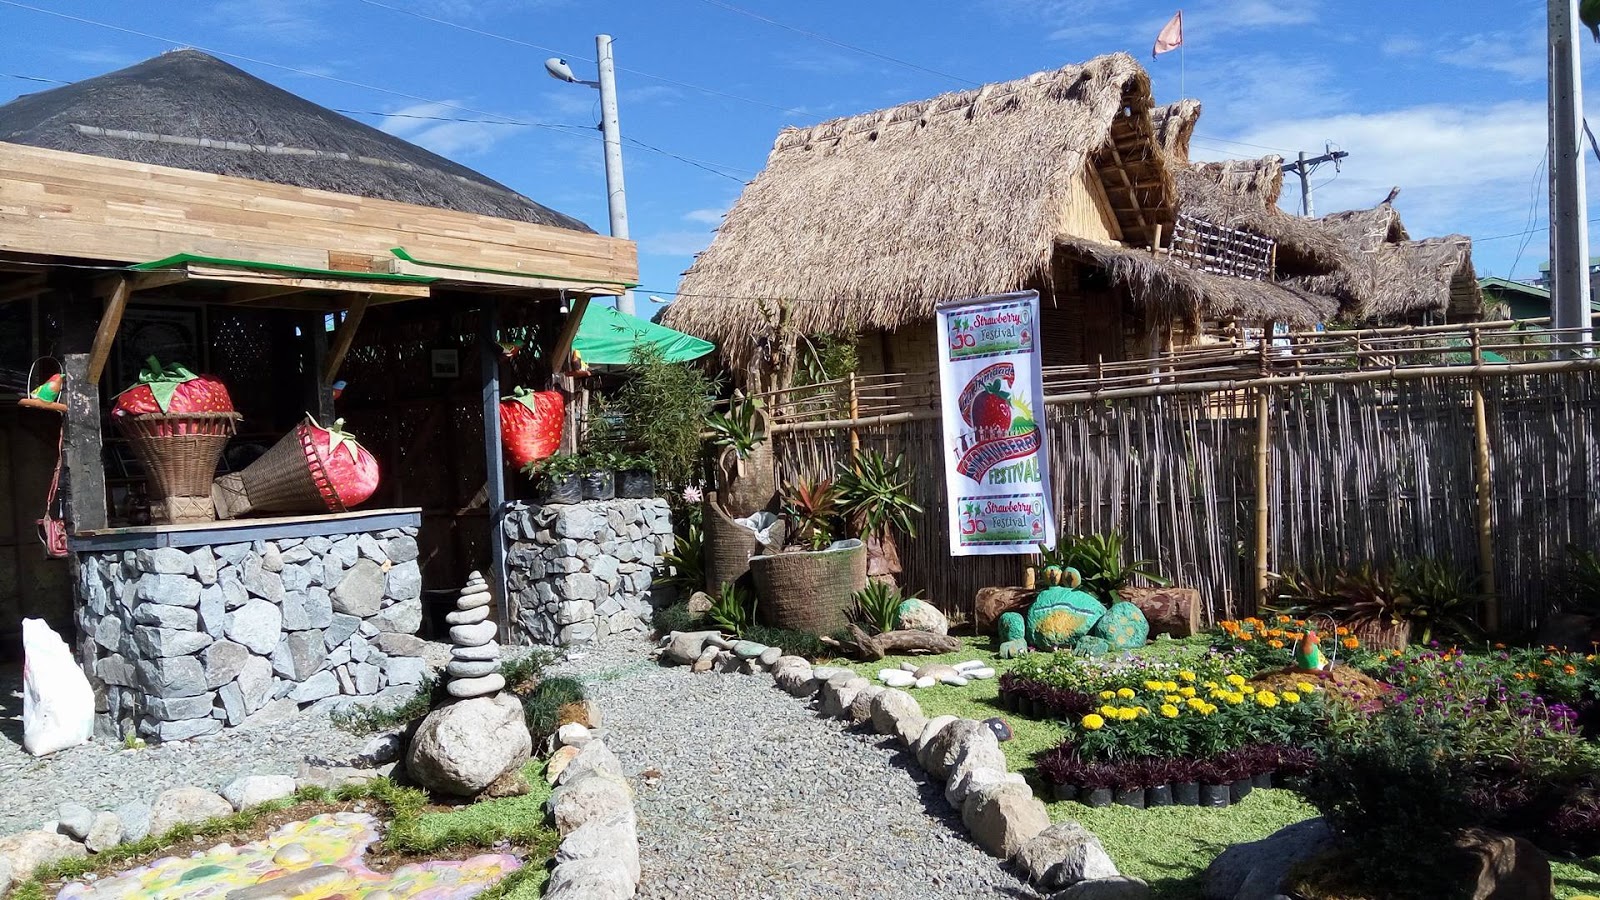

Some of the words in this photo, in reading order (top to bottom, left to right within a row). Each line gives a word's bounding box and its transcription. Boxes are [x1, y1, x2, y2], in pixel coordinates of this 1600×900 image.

[974, 312, 1021, 328] Strawberry
[980, 325, 1016, 341] Festival
[989, 455, 1042, 485] FESTIVAL
[984, 500, 1033, 517] Strawberry
[992, 514, 1027, 529] Festival
